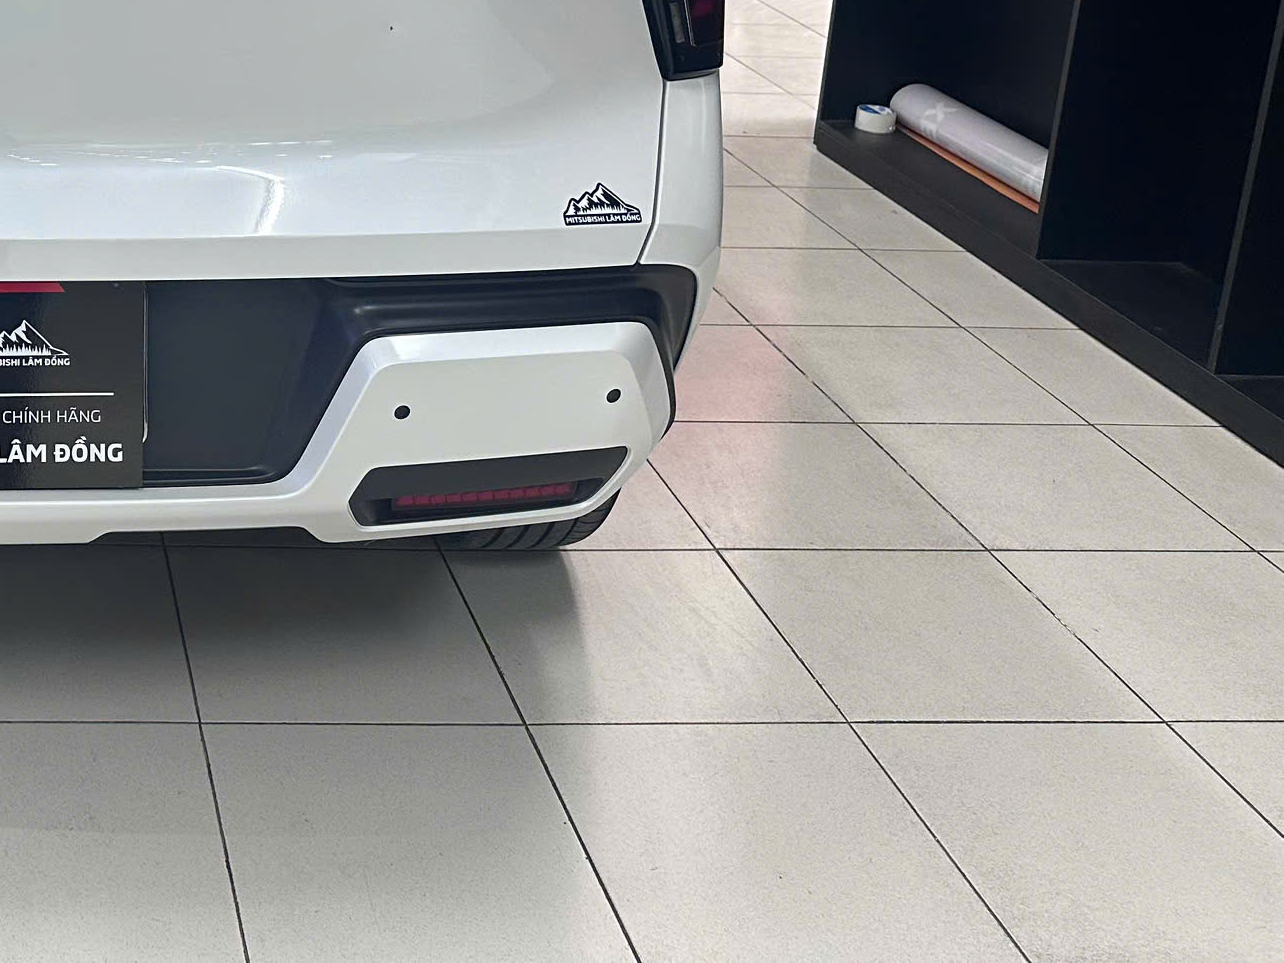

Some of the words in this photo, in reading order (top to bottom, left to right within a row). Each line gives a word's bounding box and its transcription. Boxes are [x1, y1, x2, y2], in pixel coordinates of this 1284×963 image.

[565, 215, 605, 224] MITSUBISHI
[22, 355, 43, 366] LÂM
[44, 354, 71, 366] ĐỒNG
[2, 407, 51, 424] CHÍNH
[56, 407, 101, 423] HÃNG
[53, 436, 124, 464] ĐỒNG
